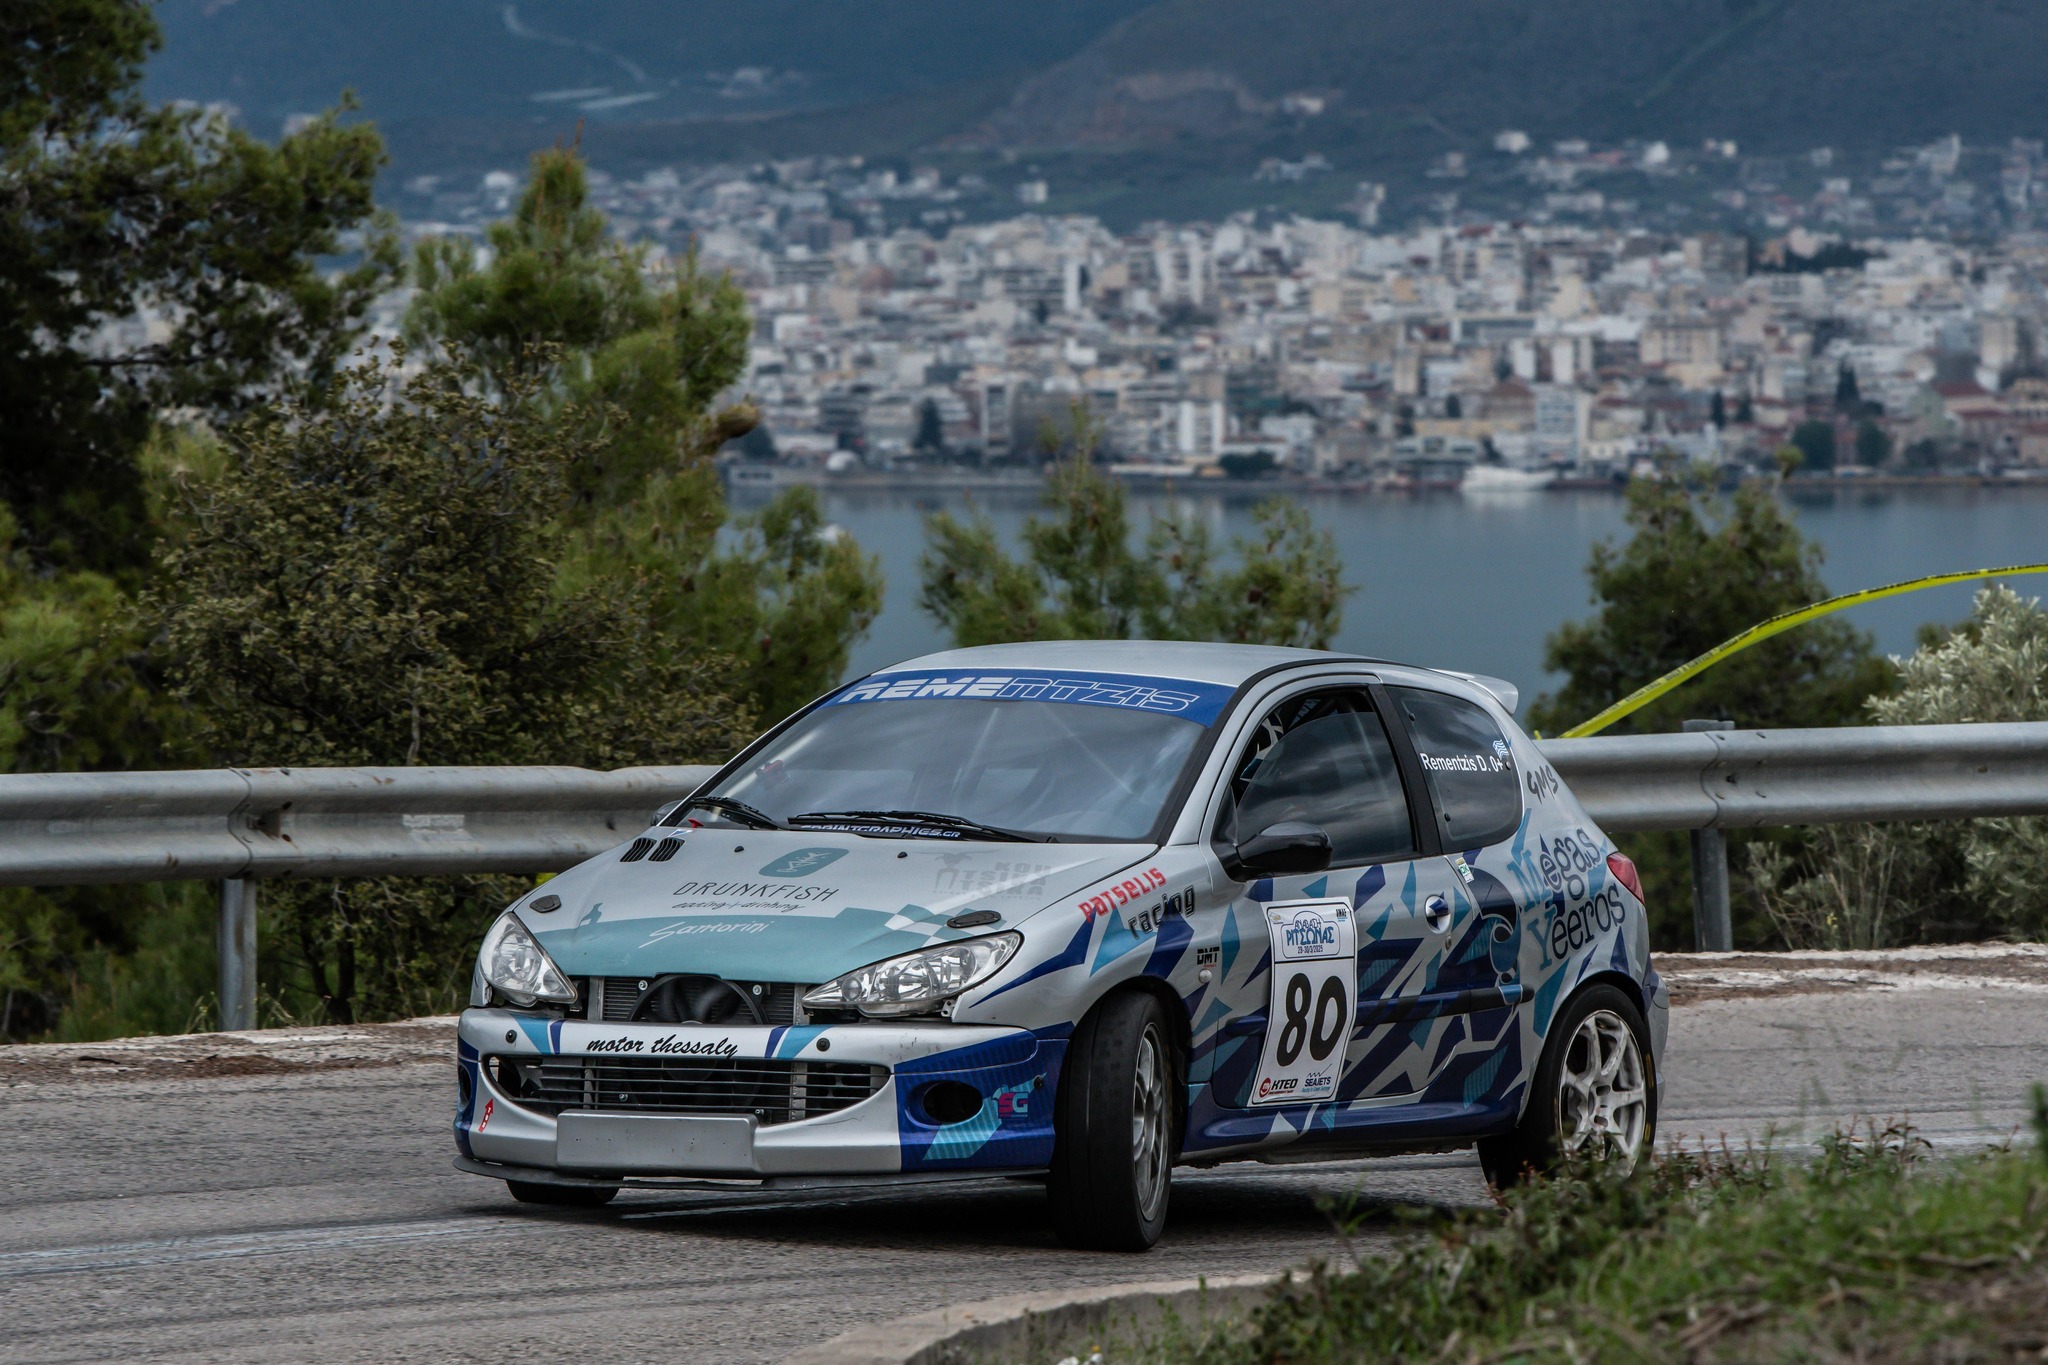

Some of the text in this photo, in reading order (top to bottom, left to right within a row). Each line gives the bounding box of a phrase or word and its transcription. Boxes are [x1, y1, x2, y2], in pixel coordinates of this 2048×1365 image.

[839, 677, 1200, 712] REMENTZIS
[1420, 752, 1477, 771] Rementzis
[1476, 754, 1491, 772] D.
[1526, 764, 1559, 804] GMS
[1507, 827, 1601, 912] Megas
[672, 882, 839, 902] DRUNKFISH
[1128, 885, 1195, 940] racing
[1527, 882, 1626, 971] Yeeros
[638, 920, 774, 948] Santorini
[1277, 973, 1347, 1067] 80
[586, 1034, 738, 1059] motor thessaly
